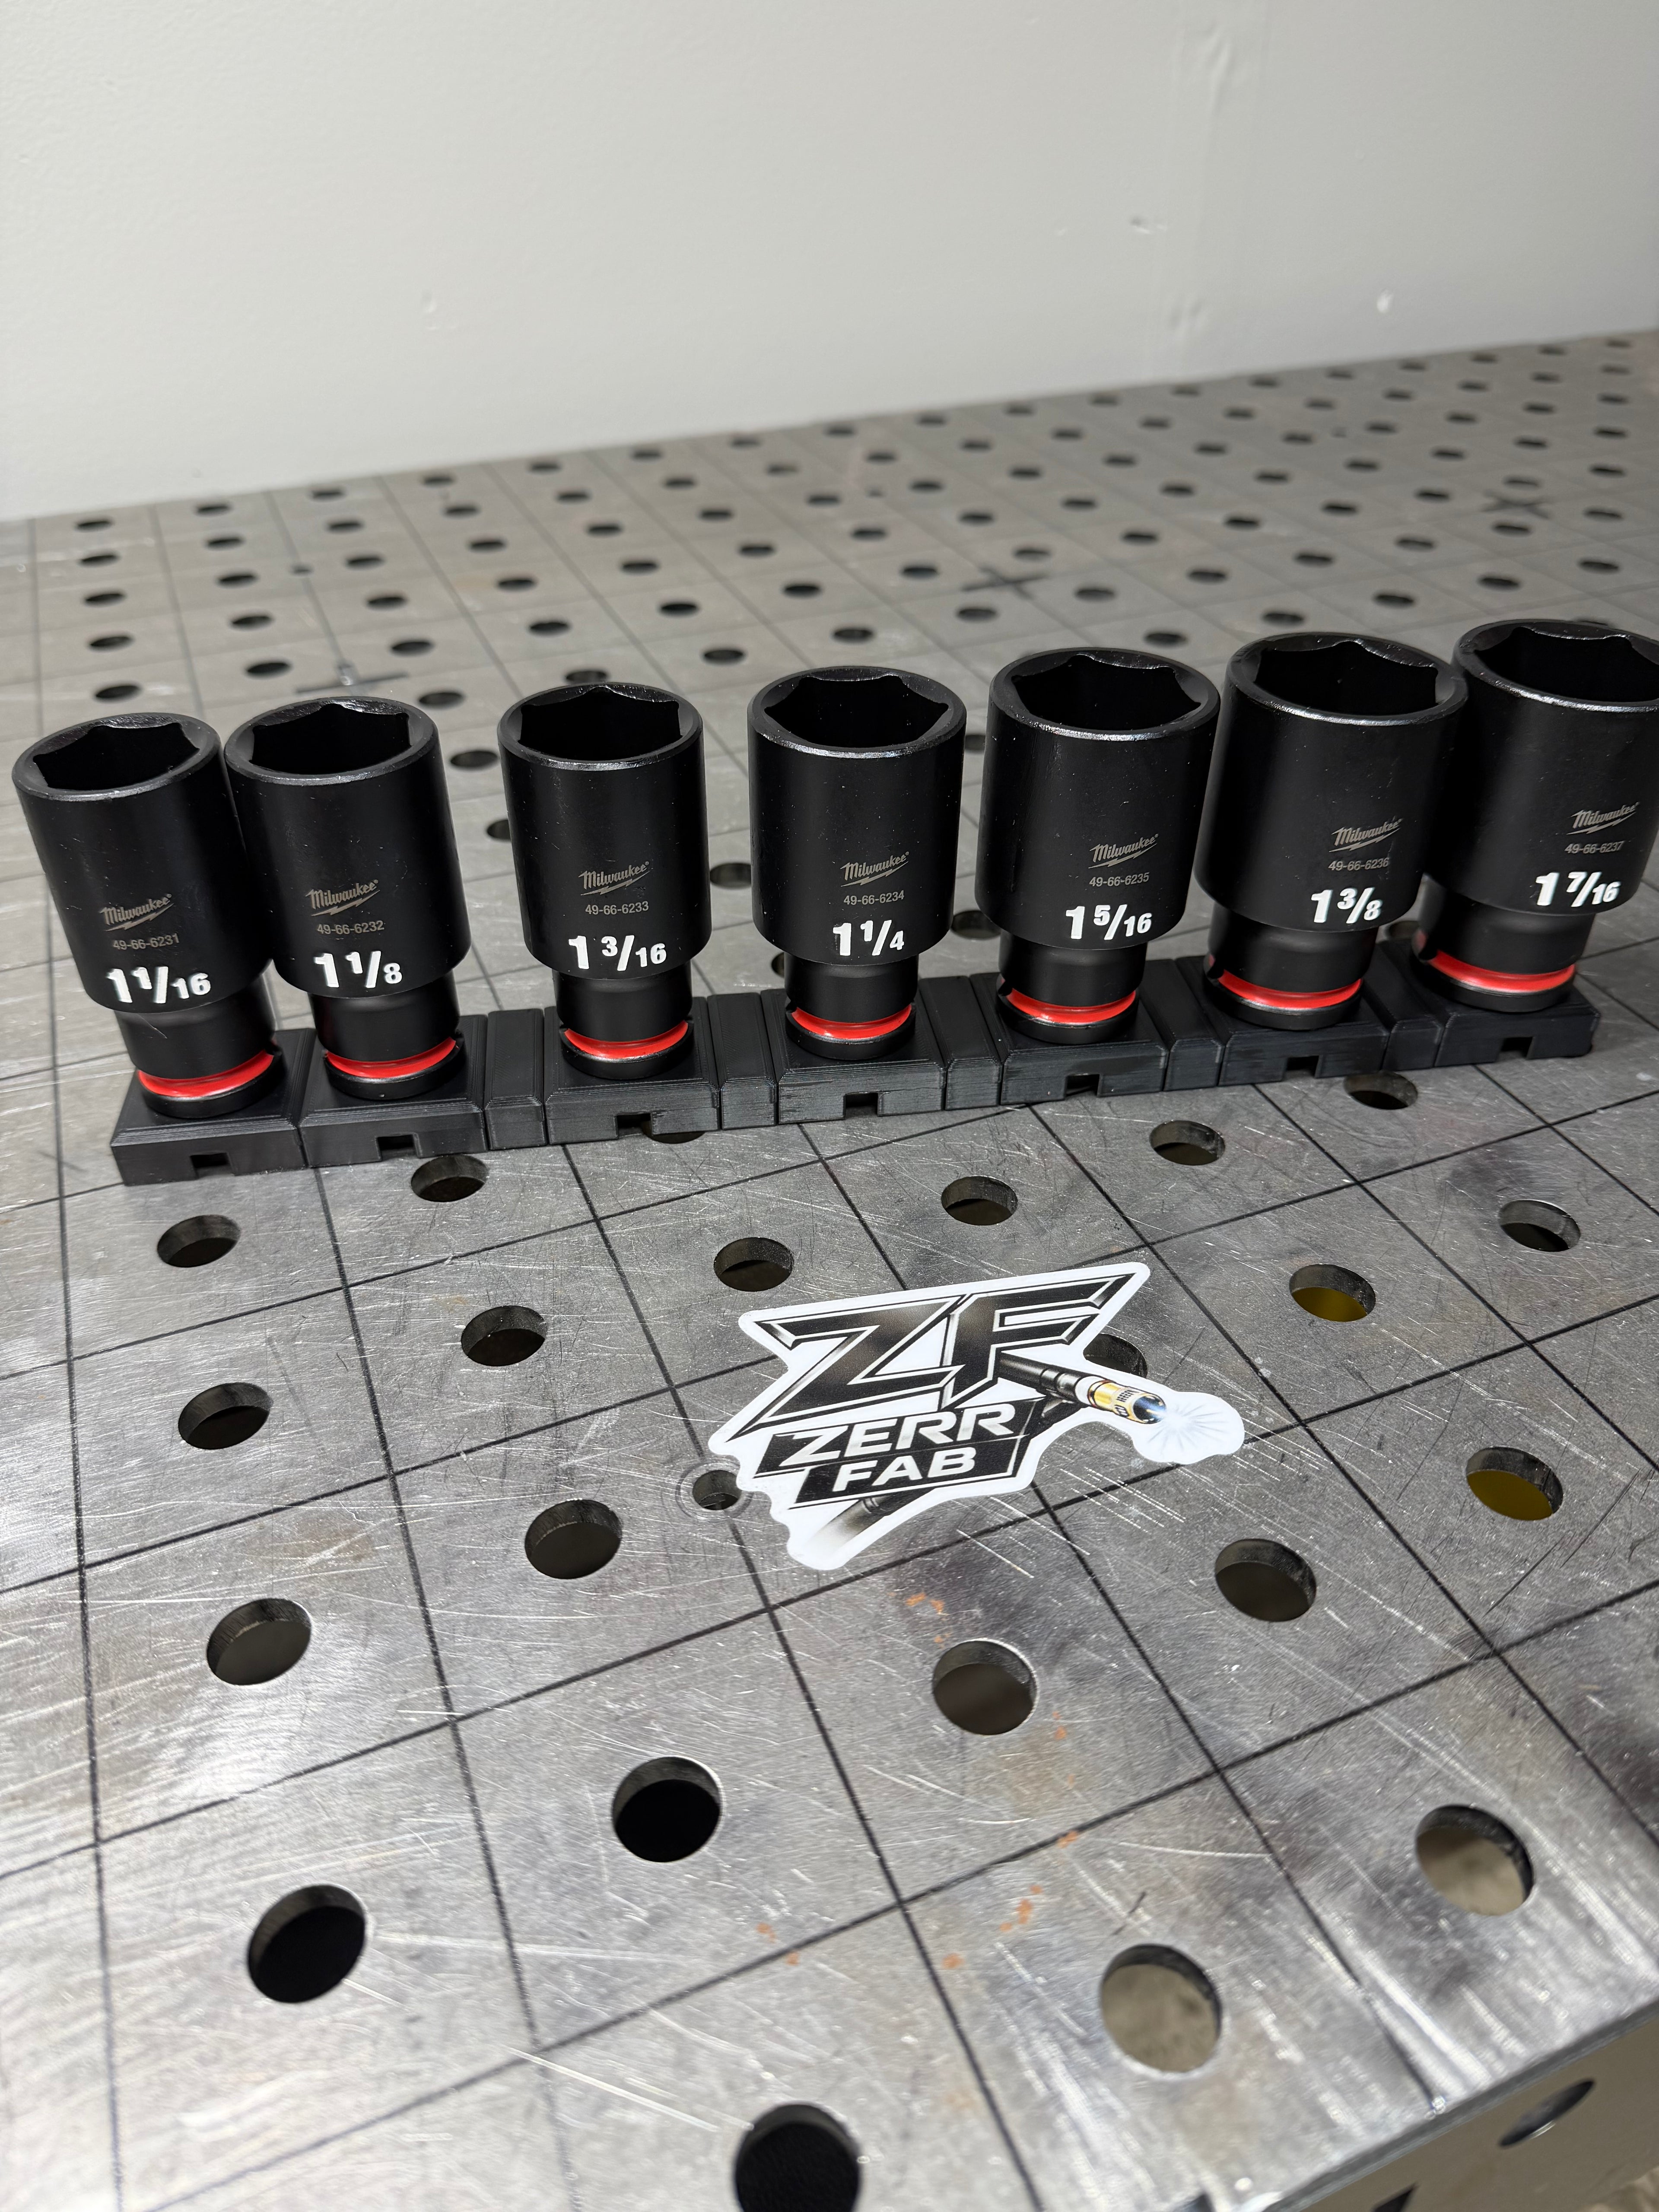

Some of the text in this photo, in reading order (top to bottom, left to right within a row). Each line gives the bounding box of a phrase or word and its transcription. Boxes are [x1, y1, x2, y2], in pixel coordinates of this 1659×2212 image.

[1564, 840, 1625, 854] 49-66-6237
[1328, 857, 1389, 871] 49-66-6236
[1089, 872, 1150, 887] 49-66-6235
[843, 890, 904, 905] 49-66-6234
[585, 901, 649, 915] 49-66-6233
[317, 920, 385, 935] 49-66-6232
[113, 933, 179, 950] 49-66-6231
[725, 1271, 1137, 1443] ZF
[779, 1403, 1018, 1468] ZERR
[831, 1447, 977, 1492] FAB
